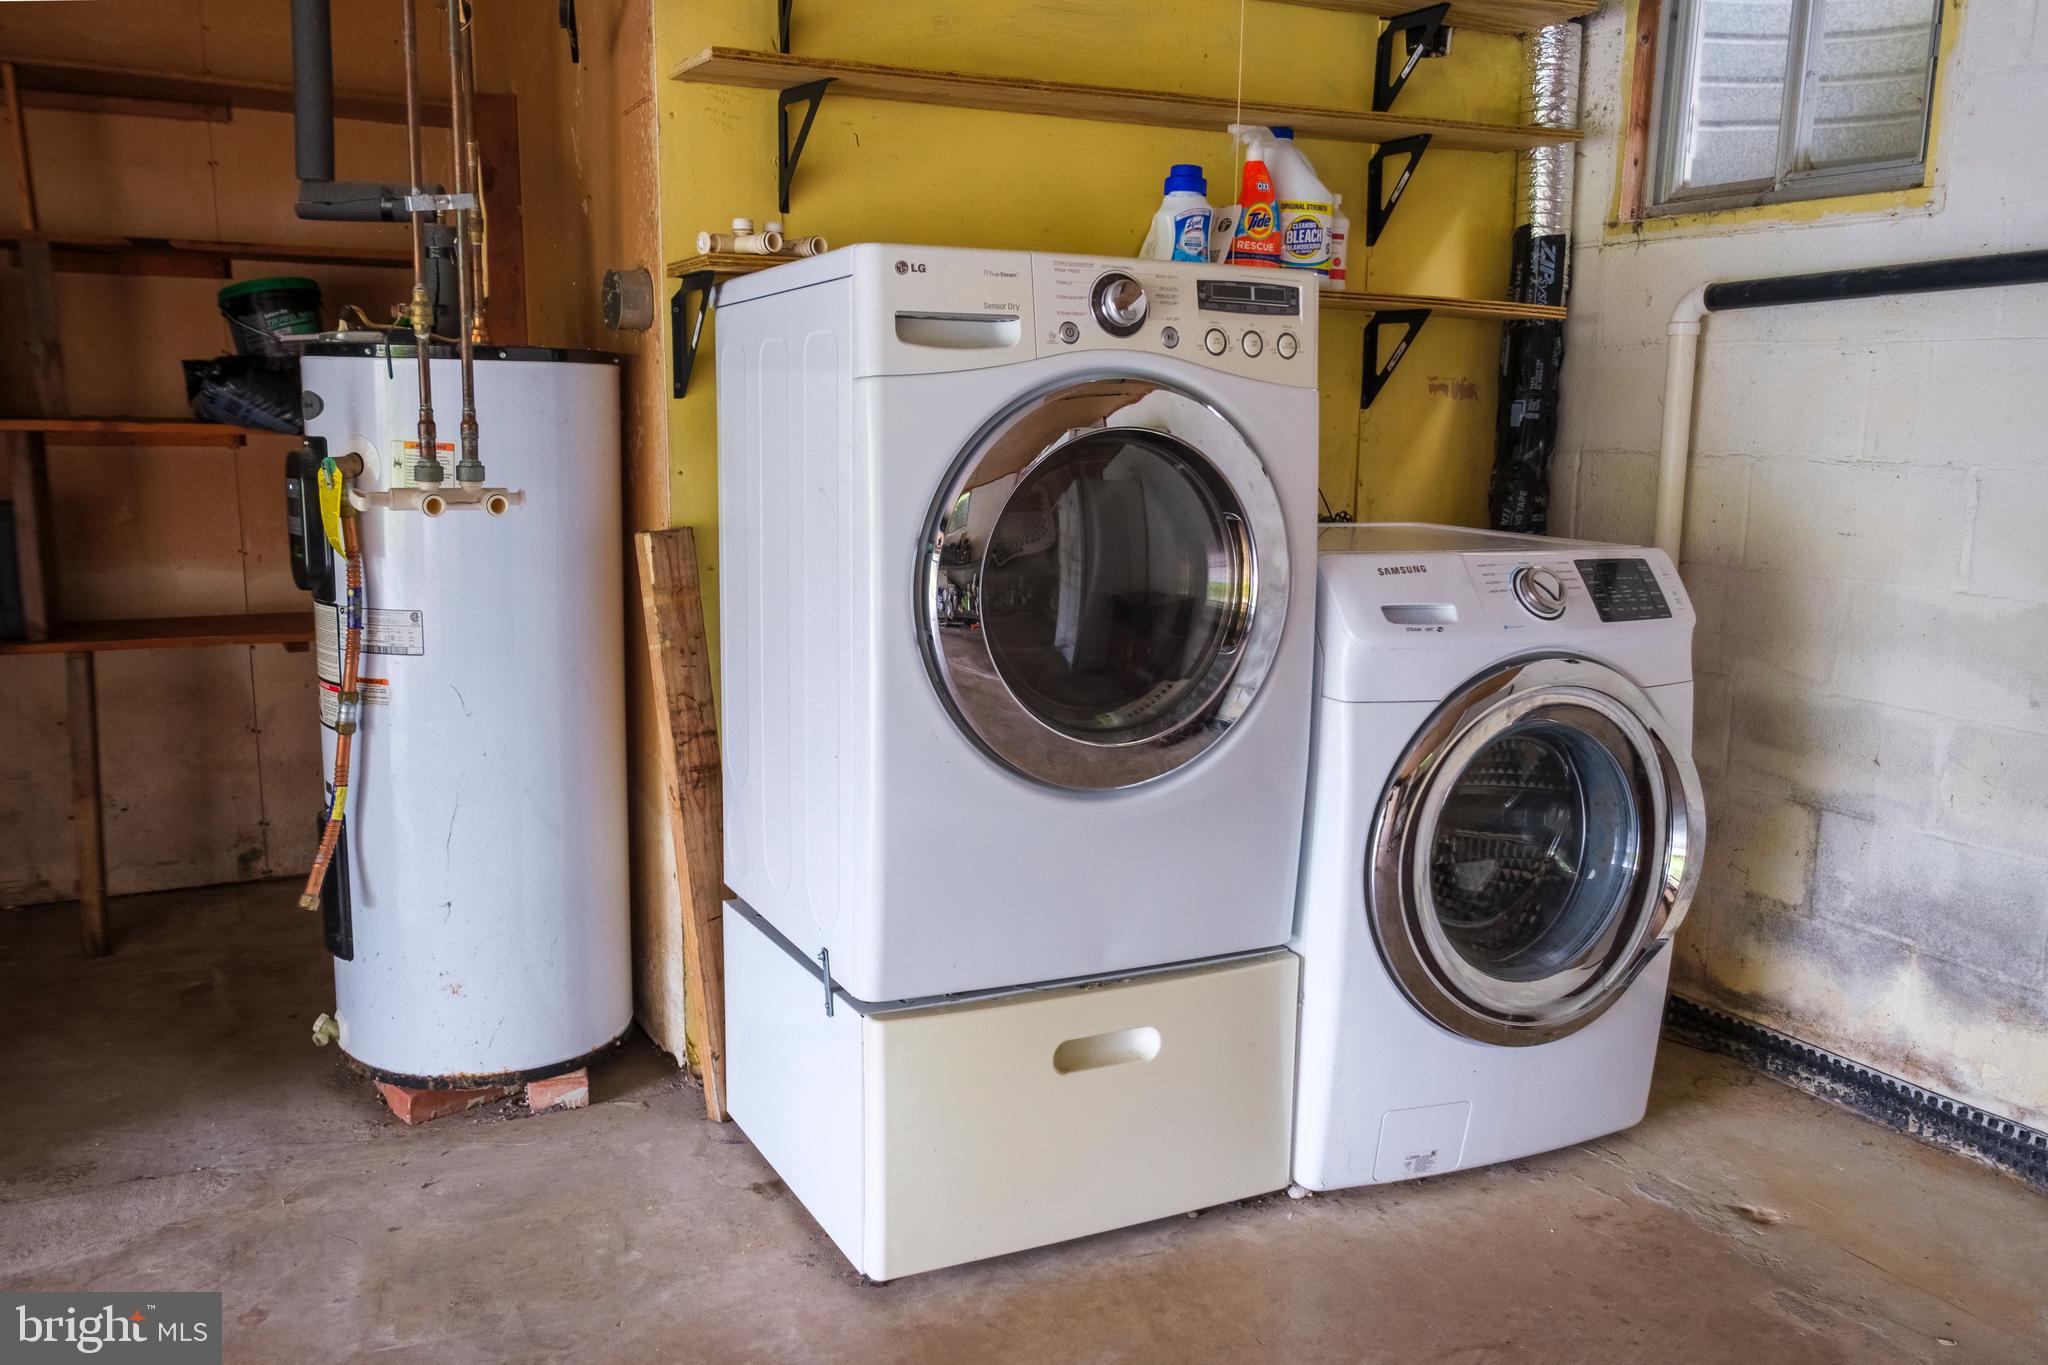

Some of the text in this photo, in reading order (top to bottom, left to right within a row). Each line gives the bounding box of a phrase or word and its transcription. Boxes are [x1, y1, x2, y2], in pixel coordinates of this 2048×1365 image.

[1247, 211, 1272, 231] Tide
[1286, 229, 1322, 244] BLEACH
[1236, 240, 1274, 252] RESCUE
[910, 263, 927, 273] LG
[983, 302, 1020, 312] Sensor Dry
[1377, 564, 1427, 576] SAMSUNG
